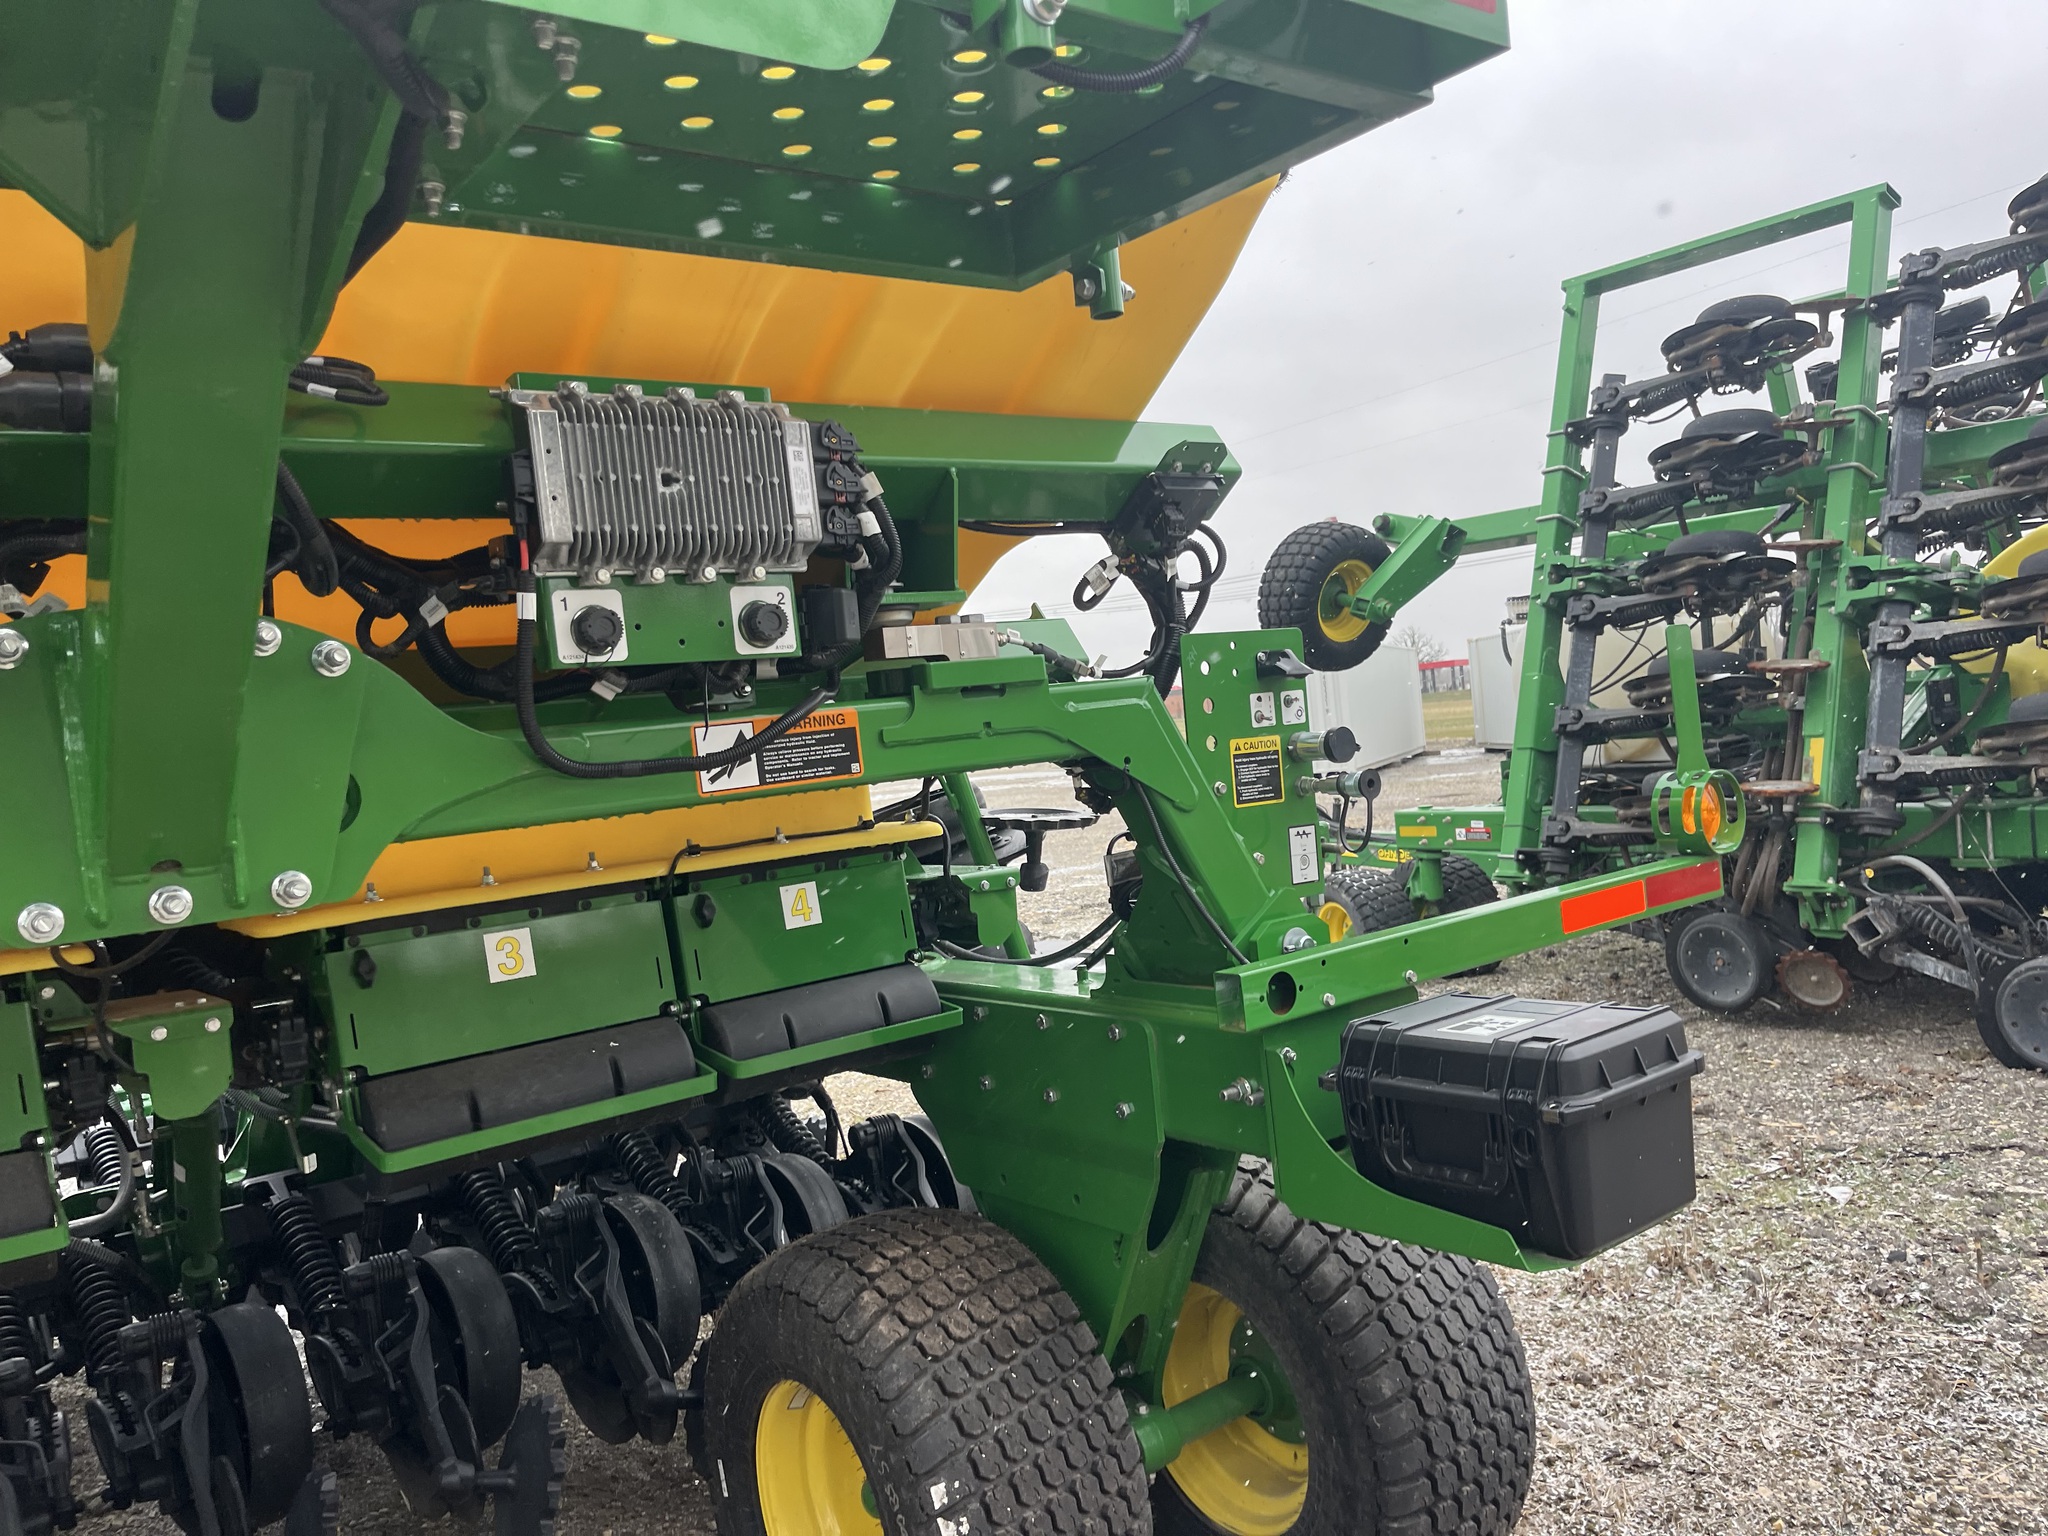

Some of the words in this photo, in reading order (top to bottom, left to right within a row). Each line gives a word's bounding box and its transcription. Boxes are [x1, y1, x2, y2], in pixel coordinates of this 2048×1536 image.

[561, 597, 567, 611] 1
[777, 592, 785, 605] 2
[793, 713, 845, 730] ARNING
[1244, 740, 1277, 750] CAUTION
[791, 888, 813, 922] 4
[496, 936, 524, 975] 3
